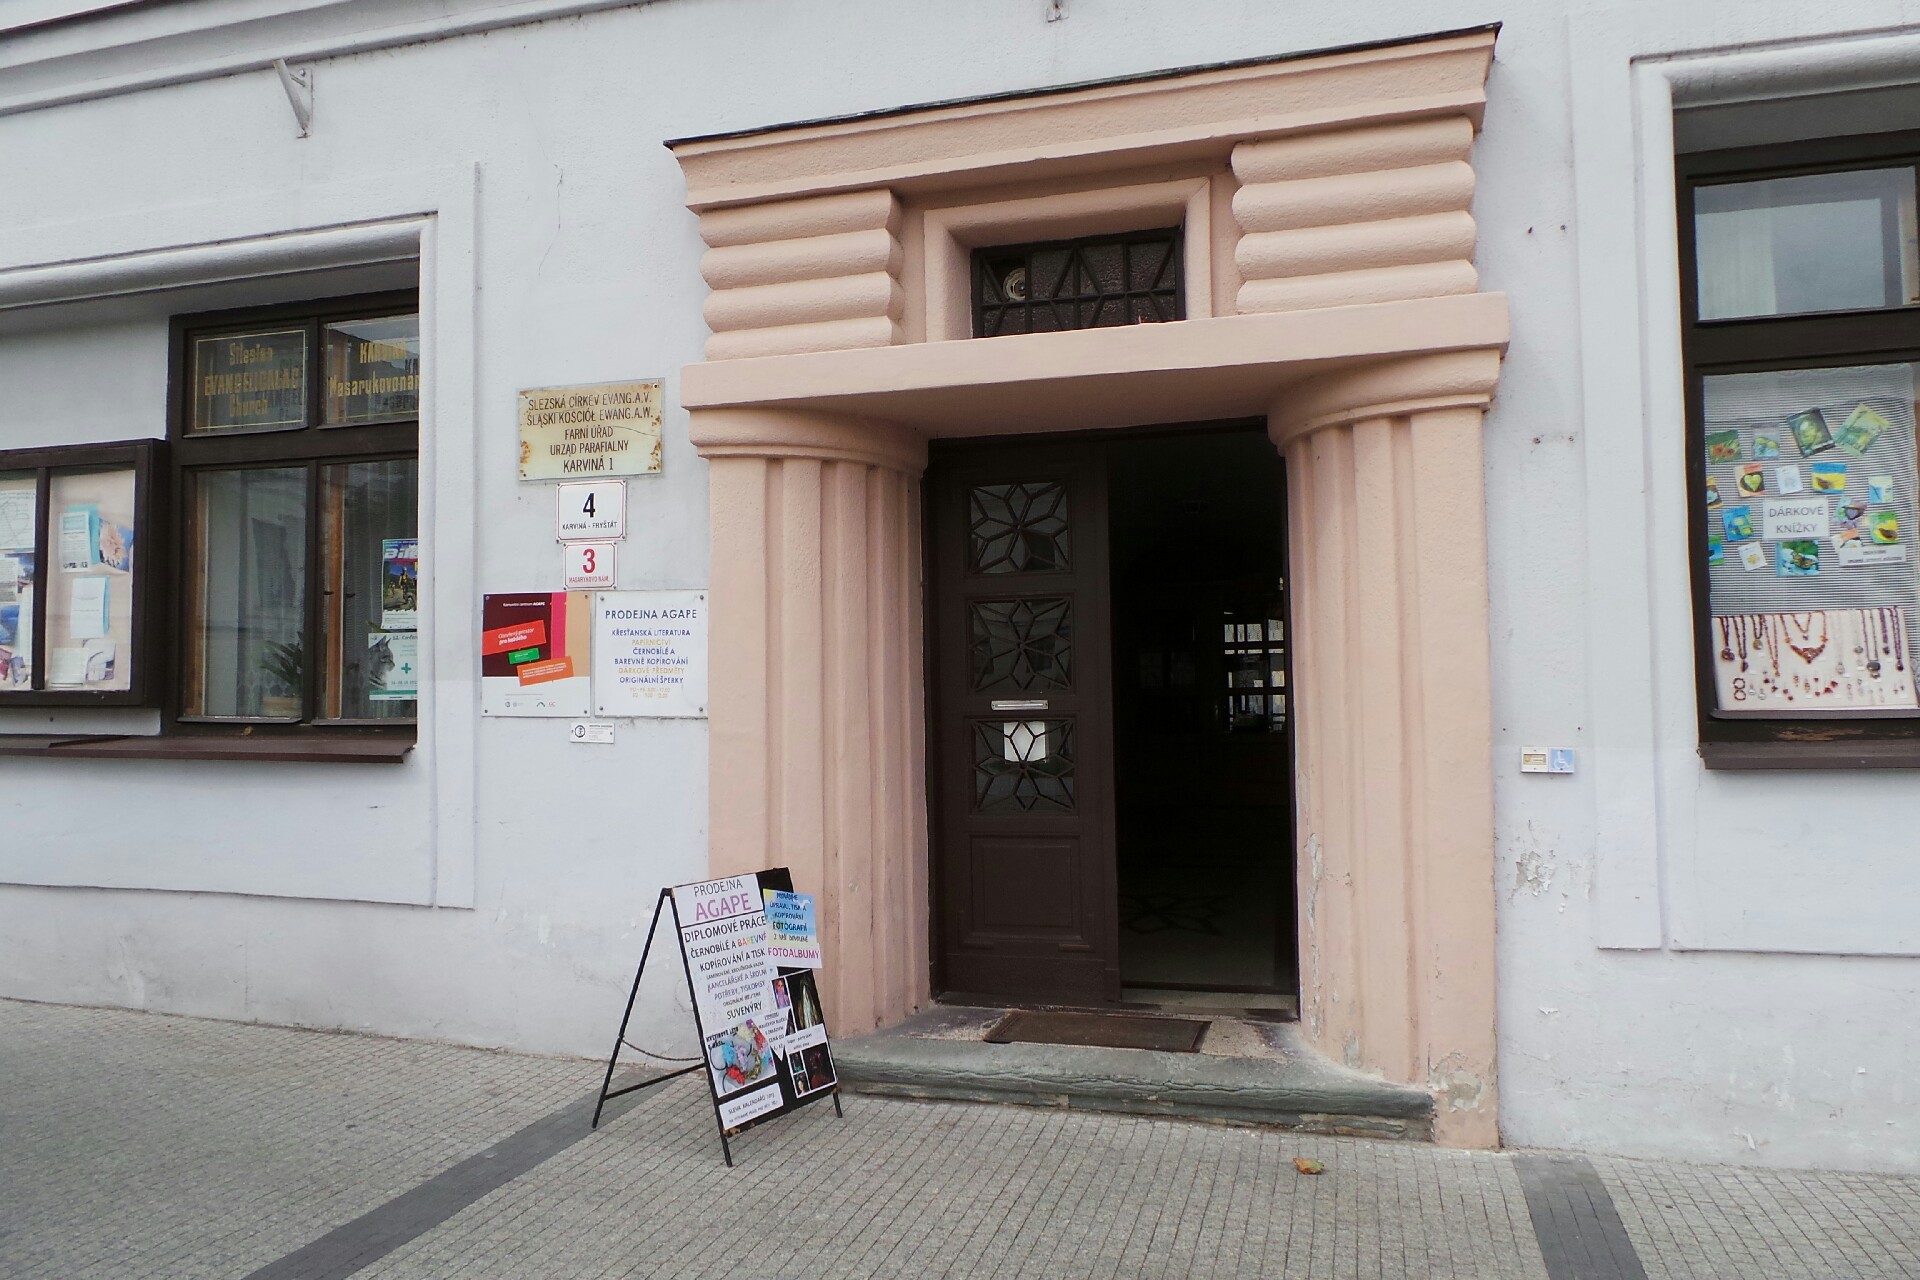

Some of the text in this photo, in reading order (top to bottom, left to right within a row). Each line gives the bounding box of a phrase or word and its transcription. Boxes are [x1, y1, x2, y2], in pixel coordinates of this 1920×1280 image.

[528, 395, 566, 411] SLEZSKÁ
[569, 393, 600, 408] CÍRKEV
[526, 411, 556, 428] ŚLĄSKI
[565, 426, 588, 440] FARNÍ
[550, 440, 629, 457] URZĄD PARAFIALNY
[563, 455, 614, 473] KARVINÁ 1
[583, 493, 596, 518] 4
[1769, 504, 1824, 518] DÁRKOVÉ
[562, 521, 586, 530] KARVINÁ
[592, 520, 617, 529] FRYŠTÁT
[1776, 522, 1818, 534] KNÍŽKY
[583, 548, 595, 574] 3
[605, 609, 697, 620] PRODEJNA AGAPE
[612, 628, 652, 637] KŘESŤANSKÁ
[632, 646, 669, 655] ČERNOBÍLÉ
[614, 656, 689, 665] BAREVNÉ KOPÍROVÁNÍ
[619, 675, 684, 684] ORIGINÁLNÍ ŠPERKY
[693, 879, 743, 897] PRODEJNA
[696, 893, 751, 921] AGAPE
[684, 915, 767, 943] DIPLOMOVÉ PRÁCE
[690, 940, 730, 959] ČERNOBÍLÉ
[737, 931, 767, 947] BAREVNÉ
[767, 947, 820, 959] FOTOALBUMY
[699, 948, 766, 972] KOPÍROVÁNÍ A TISK
[707, 973, 743, 993] KANCELÁŘSKÉ
[726, 1001, 762, 1020] SUVENÝRY
